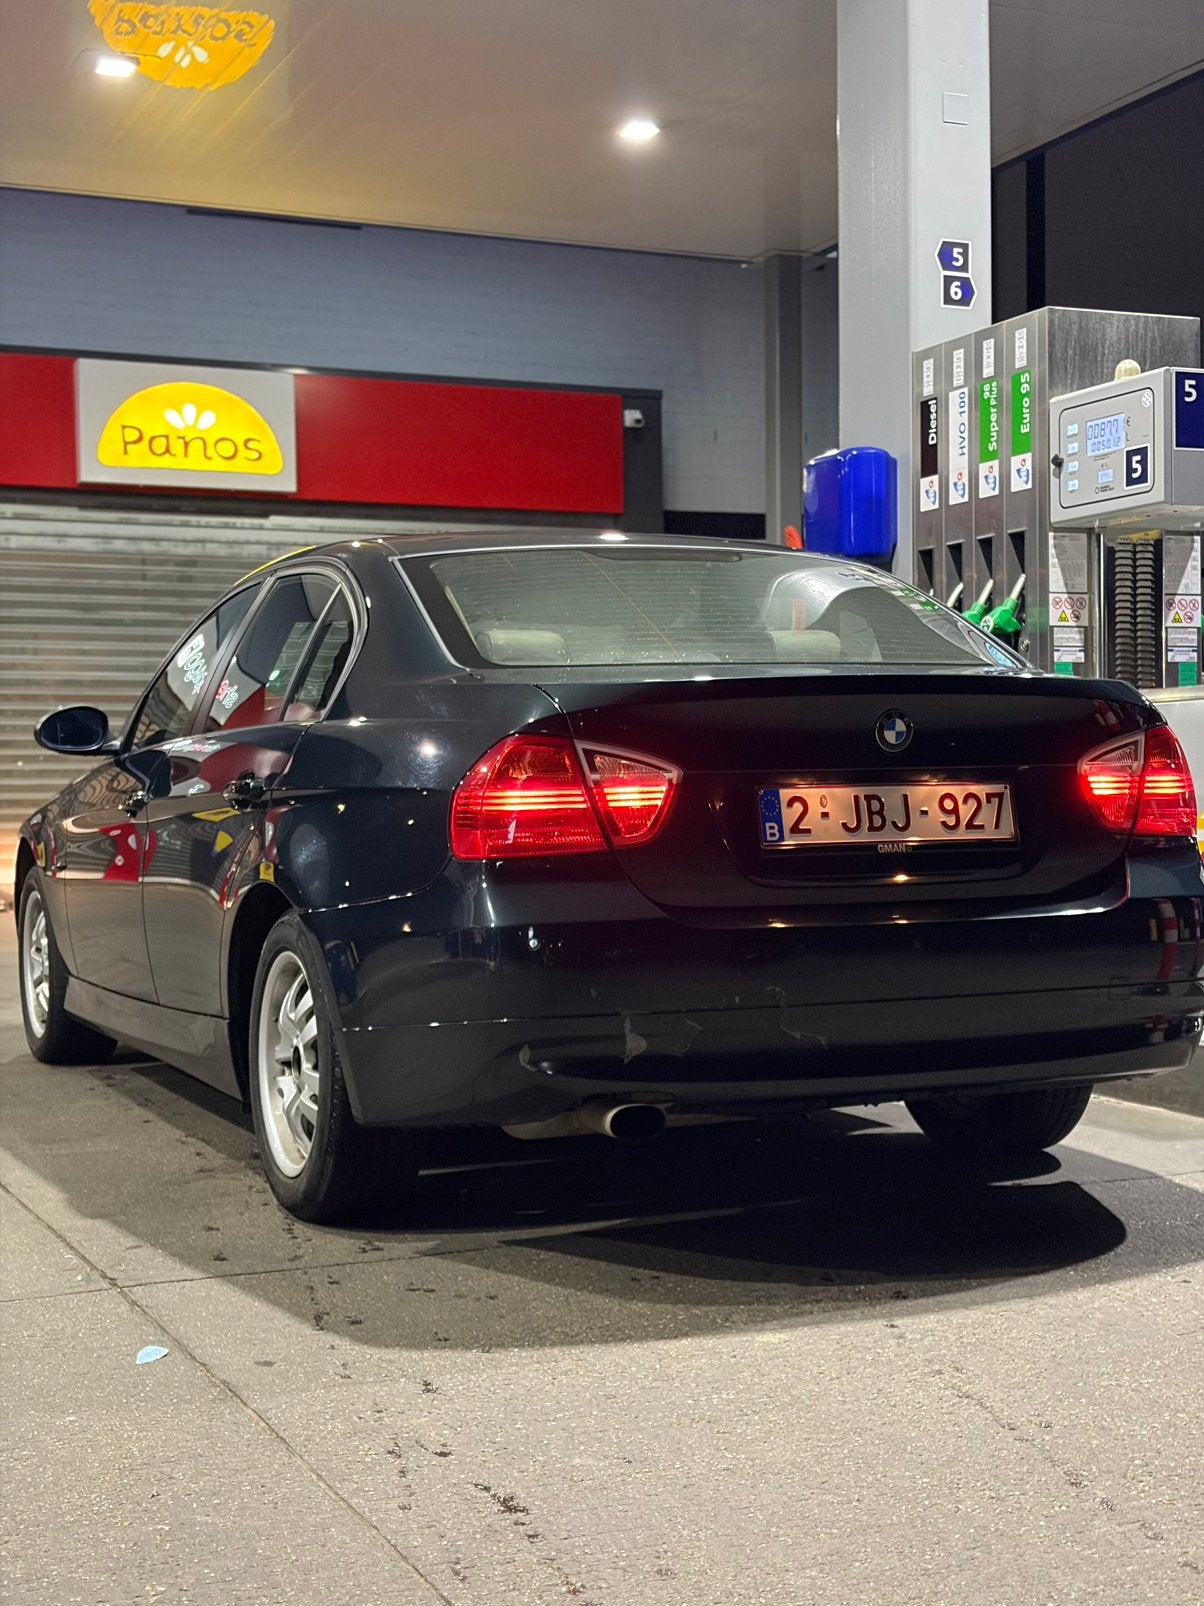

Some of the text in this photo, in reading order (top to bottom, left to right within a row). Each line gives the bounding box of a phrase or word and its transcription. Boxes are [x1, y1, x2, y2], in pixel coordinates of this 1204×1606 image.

[951, 248, 964, 267] 5
[949, 281, 962, 300] 6
[983, 383, 991, 399] 98
[1020, 372, 1030, 394] 95
[1184, 379, 1197, 402] 5
[958, 391, 966, 417] 100
[1020, 397, 1030, 433] Euro
[928, 399, 937, 445] Diesel
[988, 380, 999, 452] Super Plus
[121, 425, 263, 462] Panos
[958, 422, 966, 456] HVO
[1131, 455, 1142, 478] 5
[765, 822, 780, 841] B
